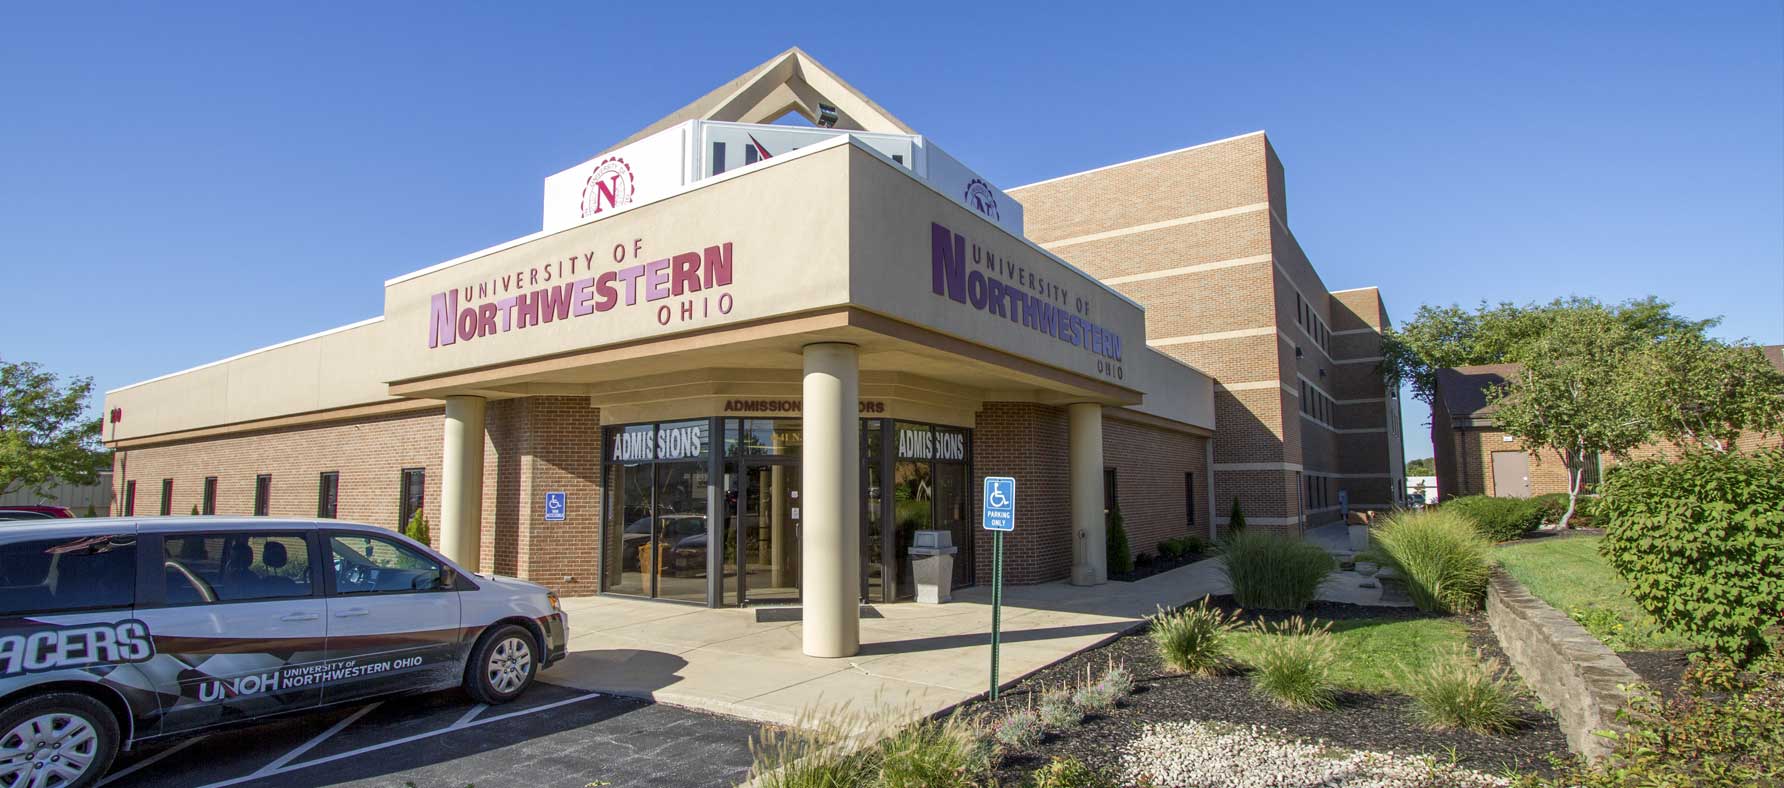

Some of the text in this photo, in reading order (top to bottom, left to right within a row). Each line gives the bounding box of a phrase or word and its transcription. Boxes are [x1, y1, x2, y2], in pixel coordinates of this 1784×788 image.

[594, 174, 620, 214] N
[464, 238, 643, 303] UNIVERSITY OF
[972, 243, 1090, 316] UNIVERSITY OF
[428, 242, 734, 348] NORTHWESTERN
[931, 221, 1122, 363] NORTHWESTERN
[657, 292, 733, 326] OHIO
[1097, 359, 1124, 381] OHIO
[724, 400, 885, 413] ADMISSION ORS
[612, 426, 701, 461] ADMISSIONS
[898, 429, 964, 461] ADMISSIONS
[987, 510, 1010, 519] PARKING
[991, 519, 1006, 527] ONLY
[0, 622, 151, 674] ACERS
[282, 656, 423, 689] NORTHWESTERN OHIO
[283, 661, 344, 678] UNIVERSITY
[200, 671, 280, 702] UNOH
